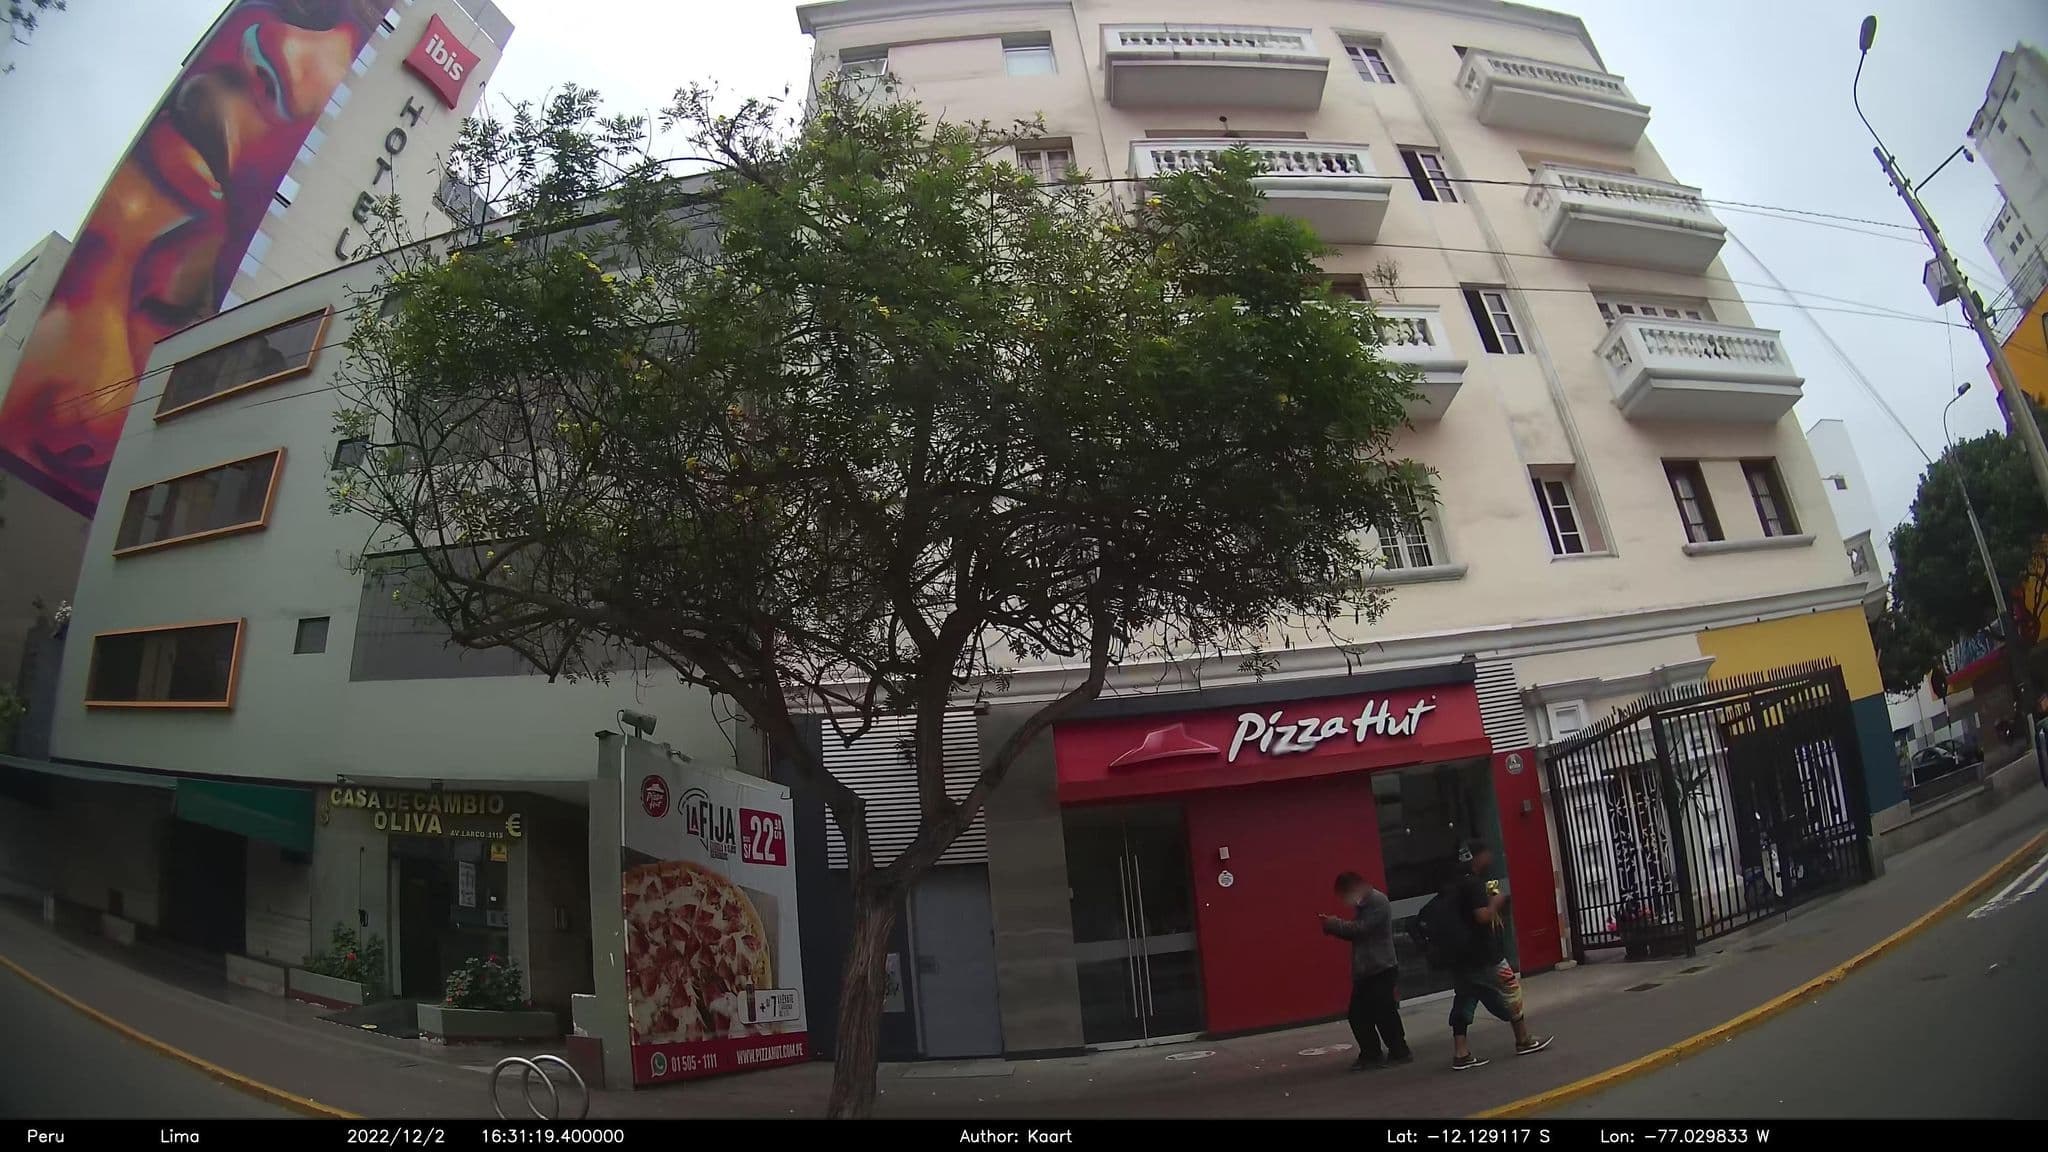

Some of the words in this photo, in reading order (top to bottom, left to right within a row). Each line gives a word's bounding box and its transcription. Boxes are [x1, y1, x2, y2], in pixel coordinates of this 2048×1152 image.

[425, 34, 464, 82] ibis
[335, 95, 424, 261] HOTEL
[1228, 711, 1349, 763] Pizza
[1352, 699, 1437, 743] Hut
[330, 788, 381, 809] CASA
[386, 794, 410, 810] DE
[414, 793, 505, 815] CAMBIO
[374, 811, 442, 834] OLIVA
[699, 801, 737, 845] FIJA
[505, 813, 522, 838] €
[751, 815, 776, 862] 22
[682, 1055, 697, 1071] 505
[703, 1053, 718, 1069] 1111
